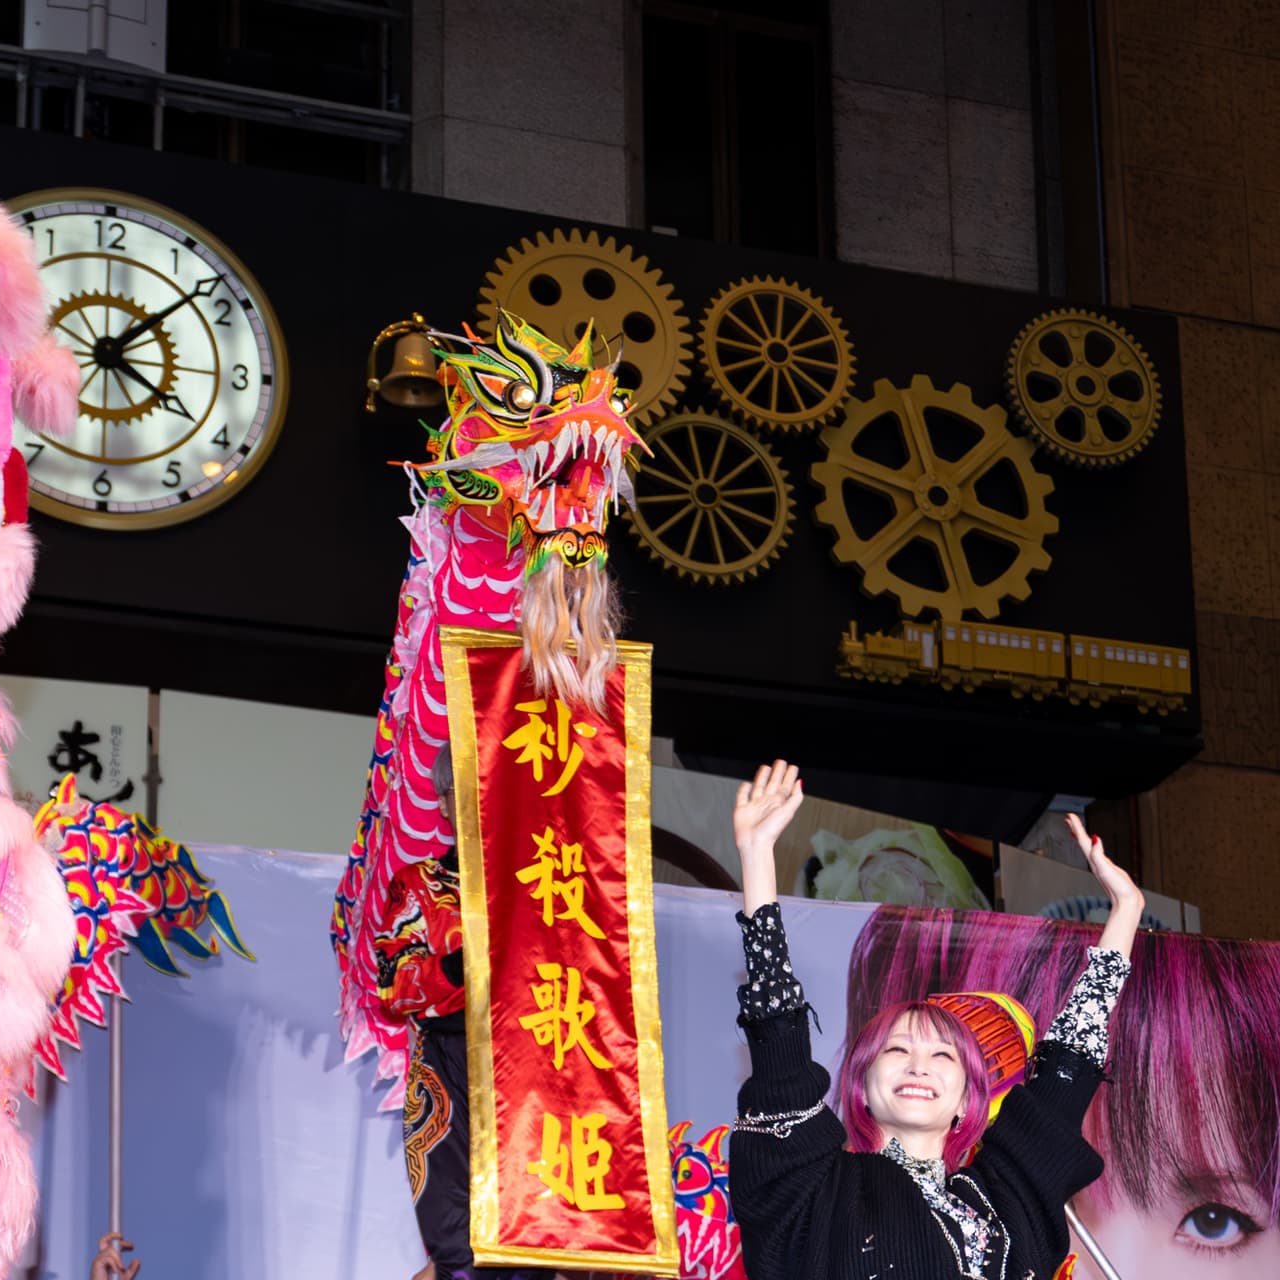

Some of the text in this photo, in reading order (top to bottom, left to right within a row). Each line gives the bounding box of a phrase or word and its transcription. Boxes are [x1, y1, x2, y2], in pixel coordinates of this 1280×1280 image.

[94, 219, 127, 251] 12
[169, 248, 180, 275] 1
[213, 298, 232, 326] 2
[230, 363, 250, 391] 3
[211, 424, 231, 450] 4
[24, 442, 46, 468] 7
[91, 469, 113, 497] 6
[161, 460, 182, 488] 5
